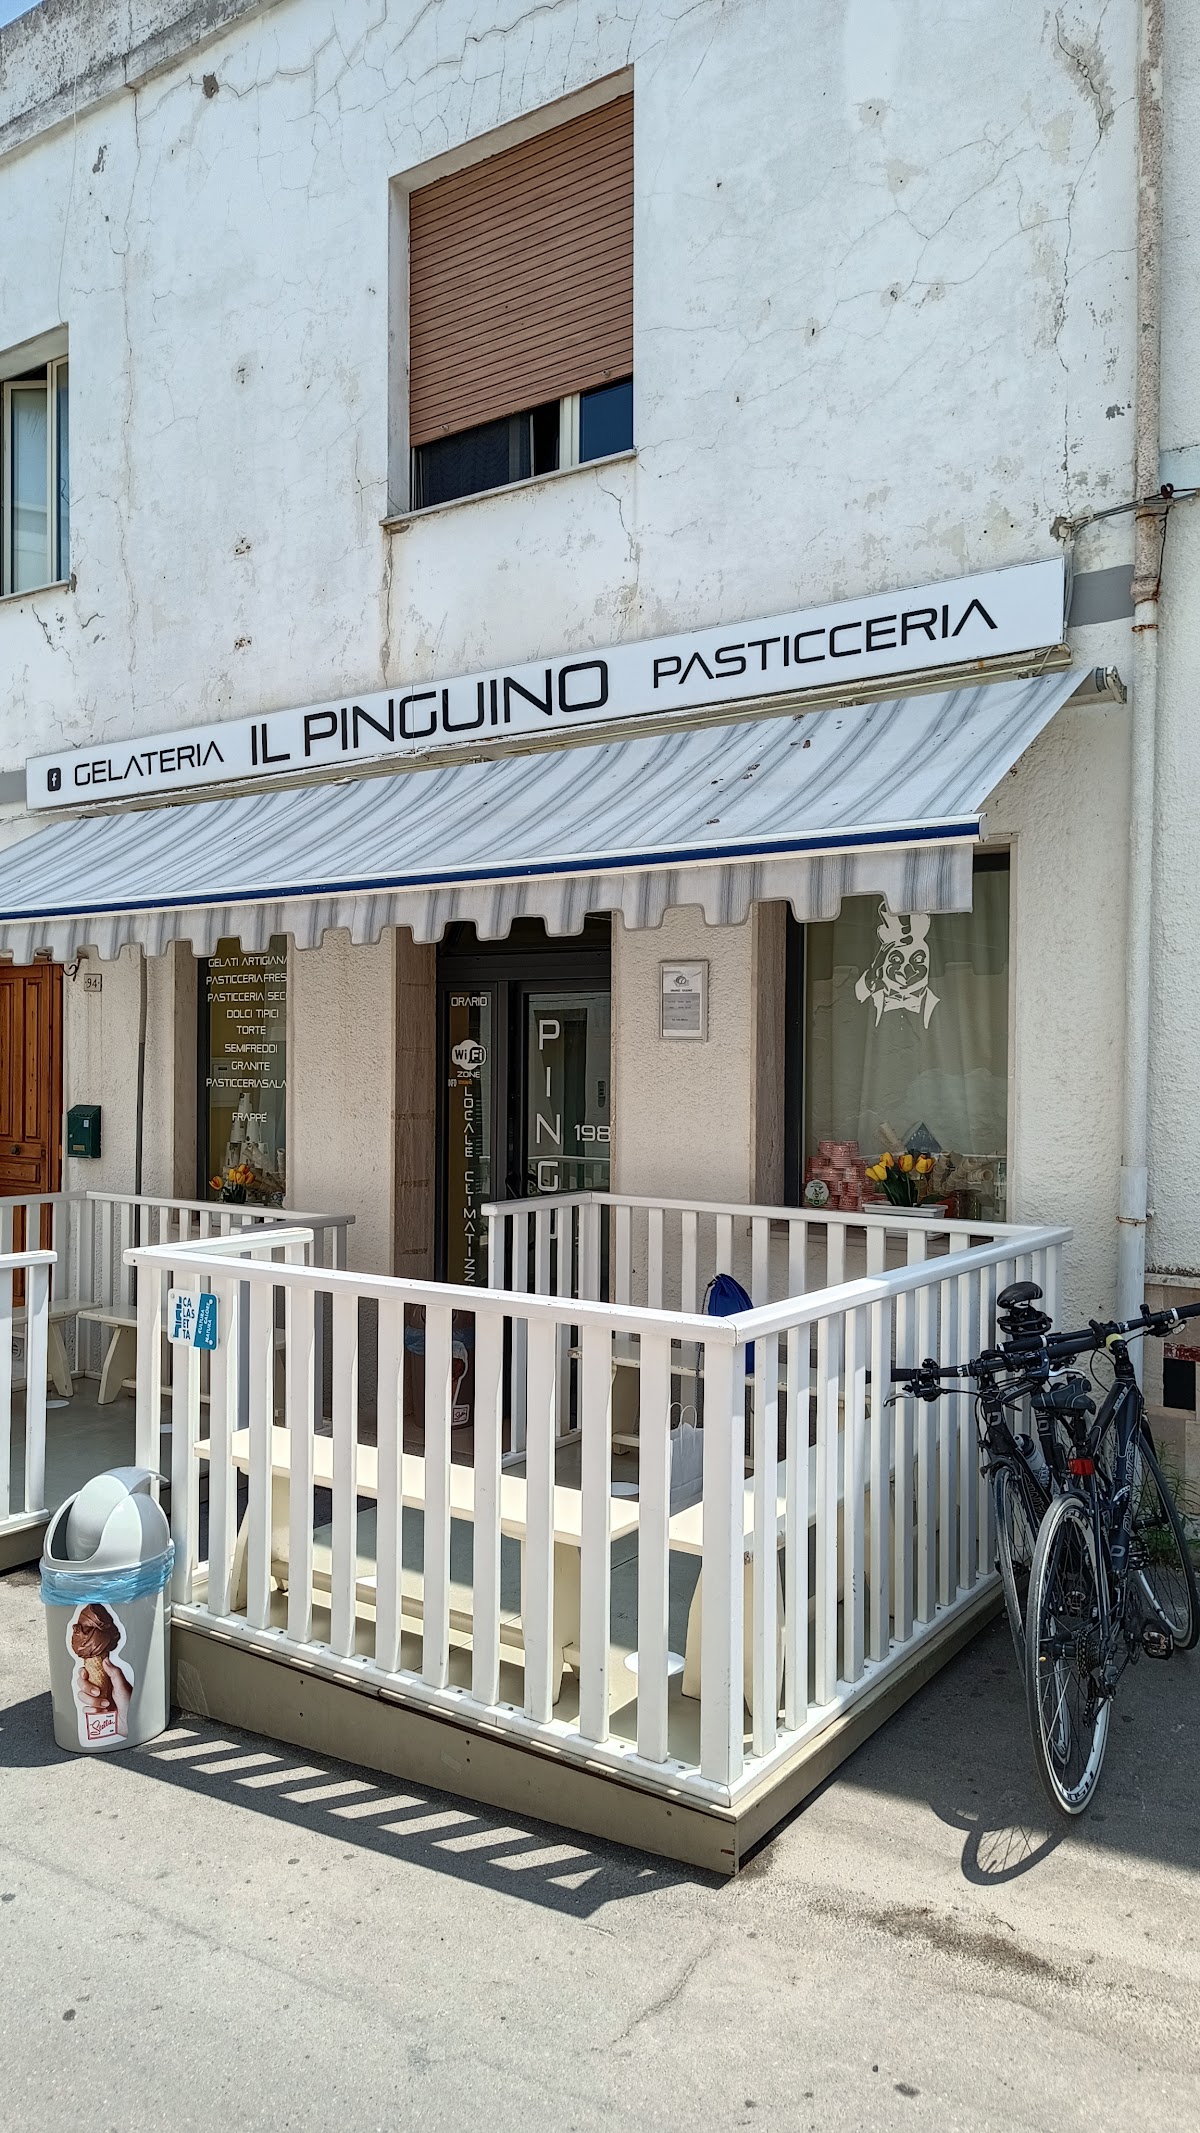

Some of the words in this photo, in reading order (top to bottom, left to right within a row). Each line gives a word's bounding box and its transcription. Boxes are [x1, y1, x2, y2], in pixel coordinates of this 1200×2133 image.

[653, 598, 998, 690] PASTICCERIA
[250, 722, 291, 767] IL
[303, 659, 609, 757] PINGUINO
[74, 740, 225, 787] GELATERIA
[208, 957, 239, 968] GELATI
[206, 973, 263, 985] PASTICCERIA
[207, 991, 265, 1002] PASTICCERIA
[267, 991, 287, 1001] SEC
[451, 996, 488, 1007] ORARIO
[226, 1009, 253, 1019] DOLCI
[255, 1008, 279, 1018] TIPICI
[236, 1025, 267, 1035] TORTE
[224, 1043, 278, 1054] SEMIFREDDI
[231, 1061, 271, 1071] GRANITE
[457, 1070, 481, 1079] ZONE
[206, 1077, 262, 1088] PASTICCERIA
[463, 1085, 475, 1158] LOCALE
[463, 1170, 477, 1287] CLIMATIZZ
